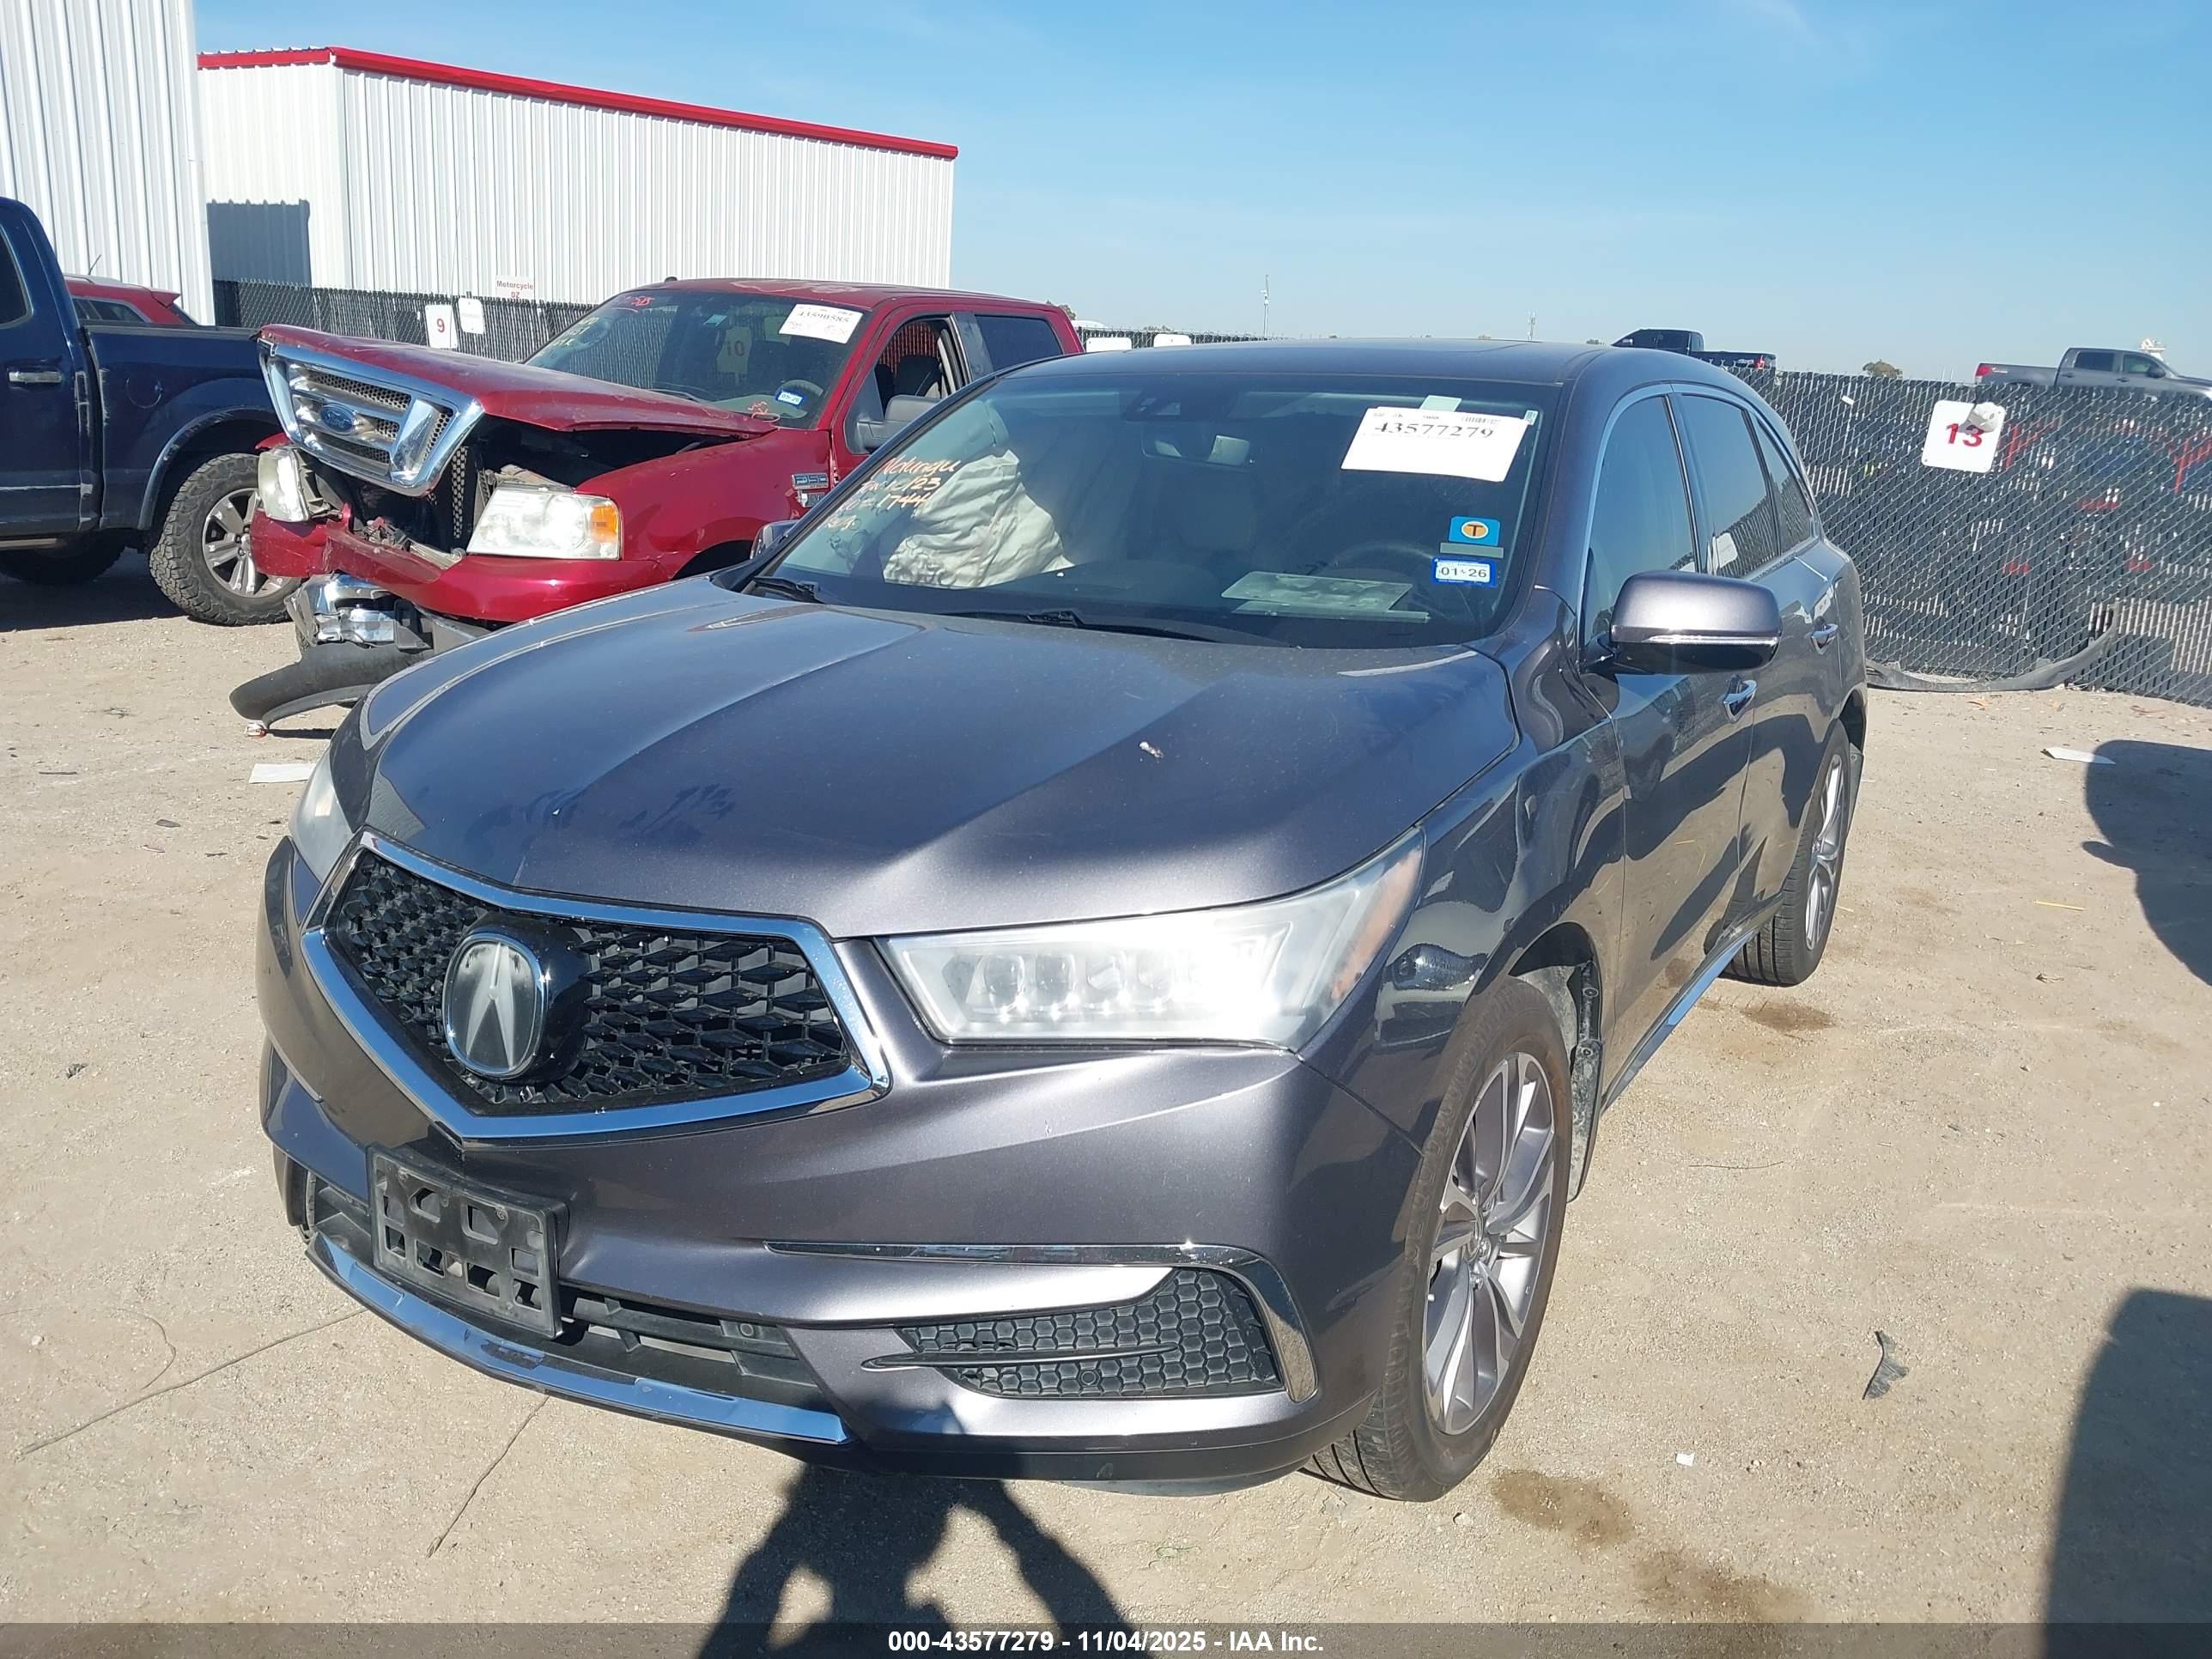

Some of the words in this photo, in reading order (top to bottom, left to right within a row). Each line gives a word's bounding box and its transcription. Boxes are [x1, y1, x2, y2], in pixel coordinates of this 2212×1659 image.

[496, 280, 534, 290] Motorcycle
[435, 318, 446, 333] 9
[1374, 422, 1495, 438] 43577279
[1946, 422, 1983, 447] 13
[1467, 523, 1485, 537] T
